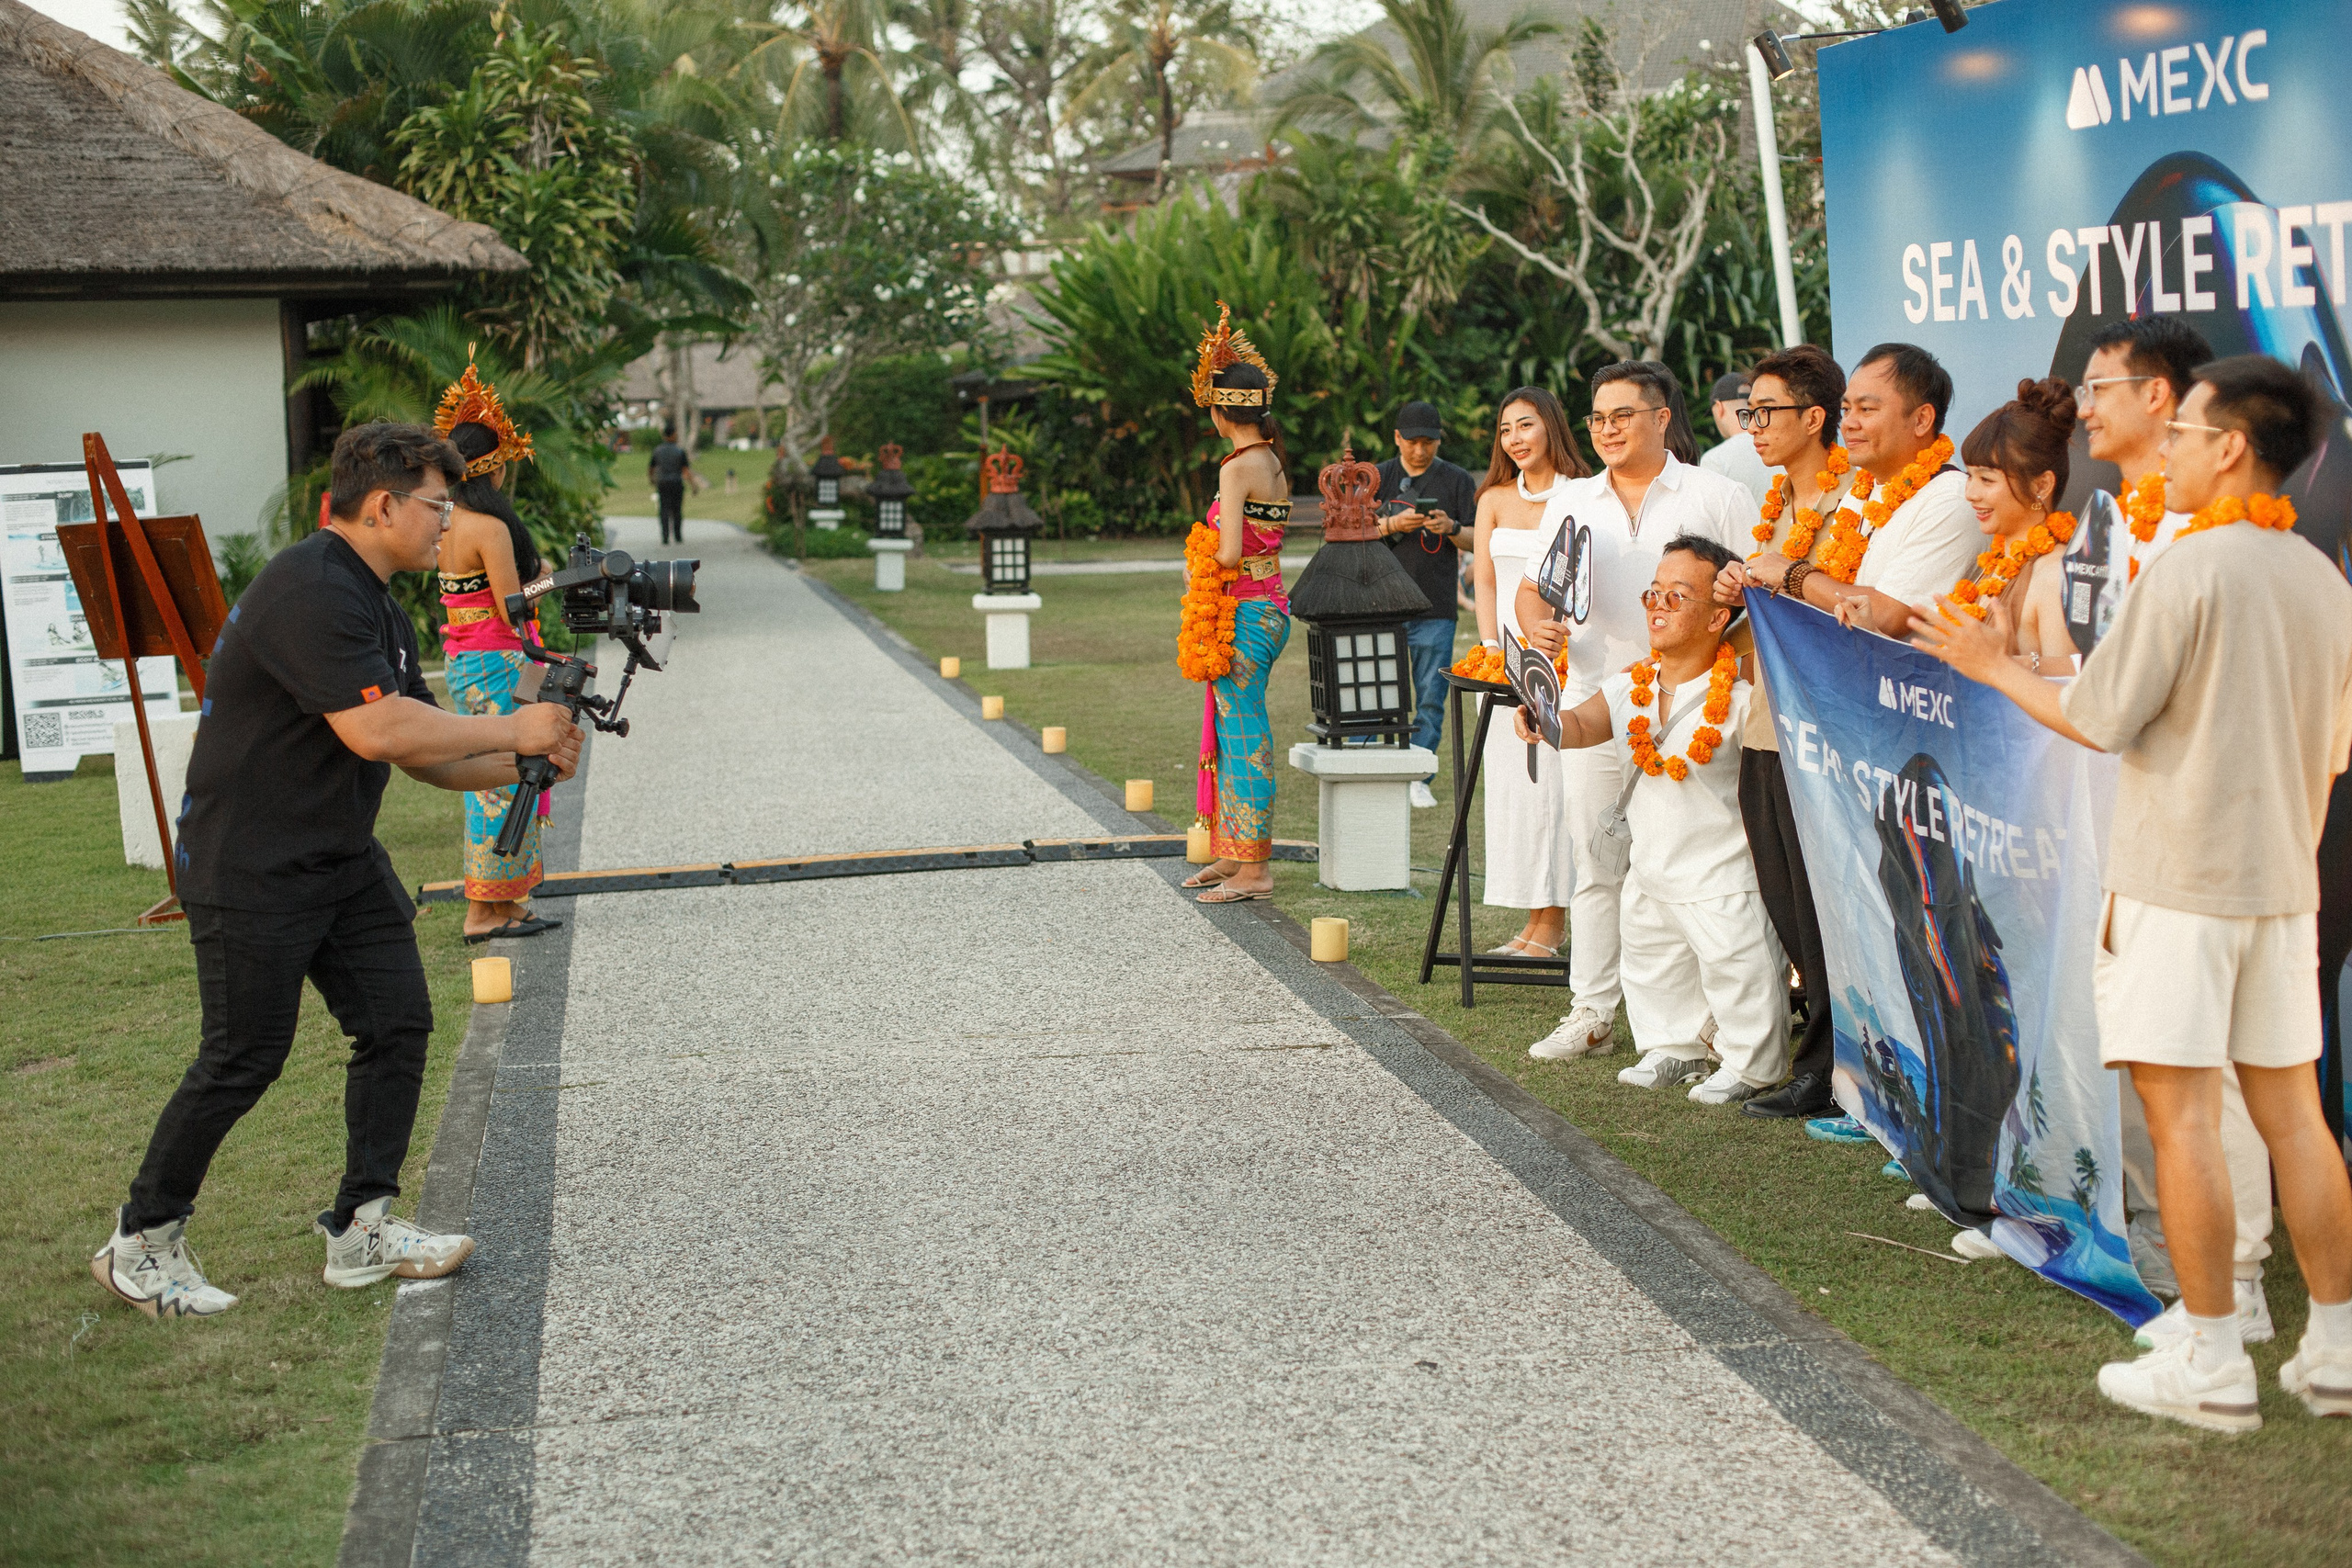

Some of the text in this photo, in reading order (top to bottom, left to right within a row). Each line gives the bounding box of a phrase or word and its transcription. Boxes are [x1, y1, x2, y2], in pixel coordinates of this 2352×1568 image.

[2120, 28, 2269, 121] MEXC
[1902, 239, 1989, 323] SEA
[2000, 234, 2036, 321] &
[2046, 215, 2217, 318] STYLE
[524, 577, 554, 597] RONIN
[1899, 681, 1955, 729] MEXC
[1852, 760, 1945, 842] STYLE
